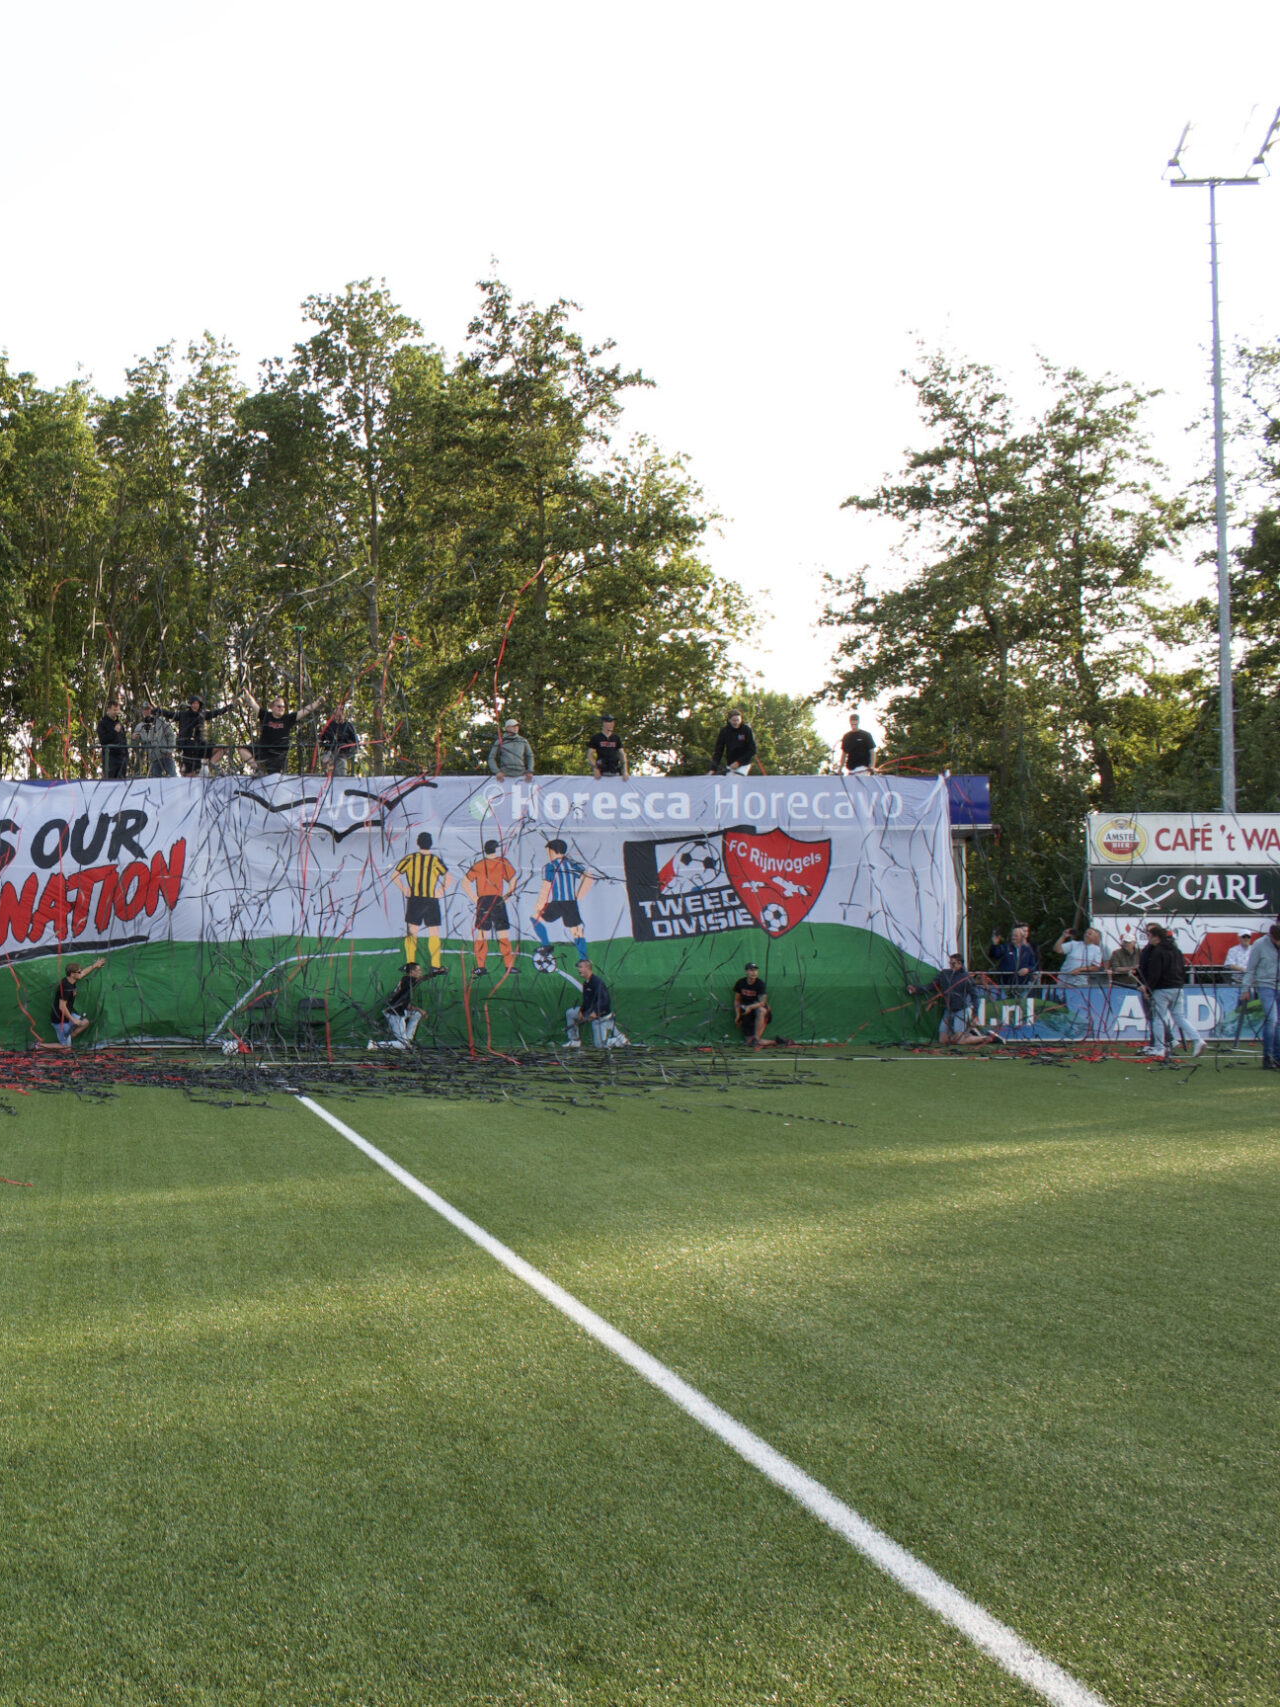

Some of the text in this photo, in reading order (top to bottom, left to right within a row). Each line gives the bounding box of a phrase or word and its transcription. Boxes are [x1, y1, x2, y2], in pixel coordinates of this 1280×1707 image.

[511, 784, 903, 820] Horesca Horecavo
[31, 809, 148, 869] OUR
[1155, 823, 1213, 851] CAFÉ
[729, 840, 822, 874] FC Rijnvogels
[1178, 874, 1269, 910] CARL
[651, 908, 755, 938] DIVISIE
